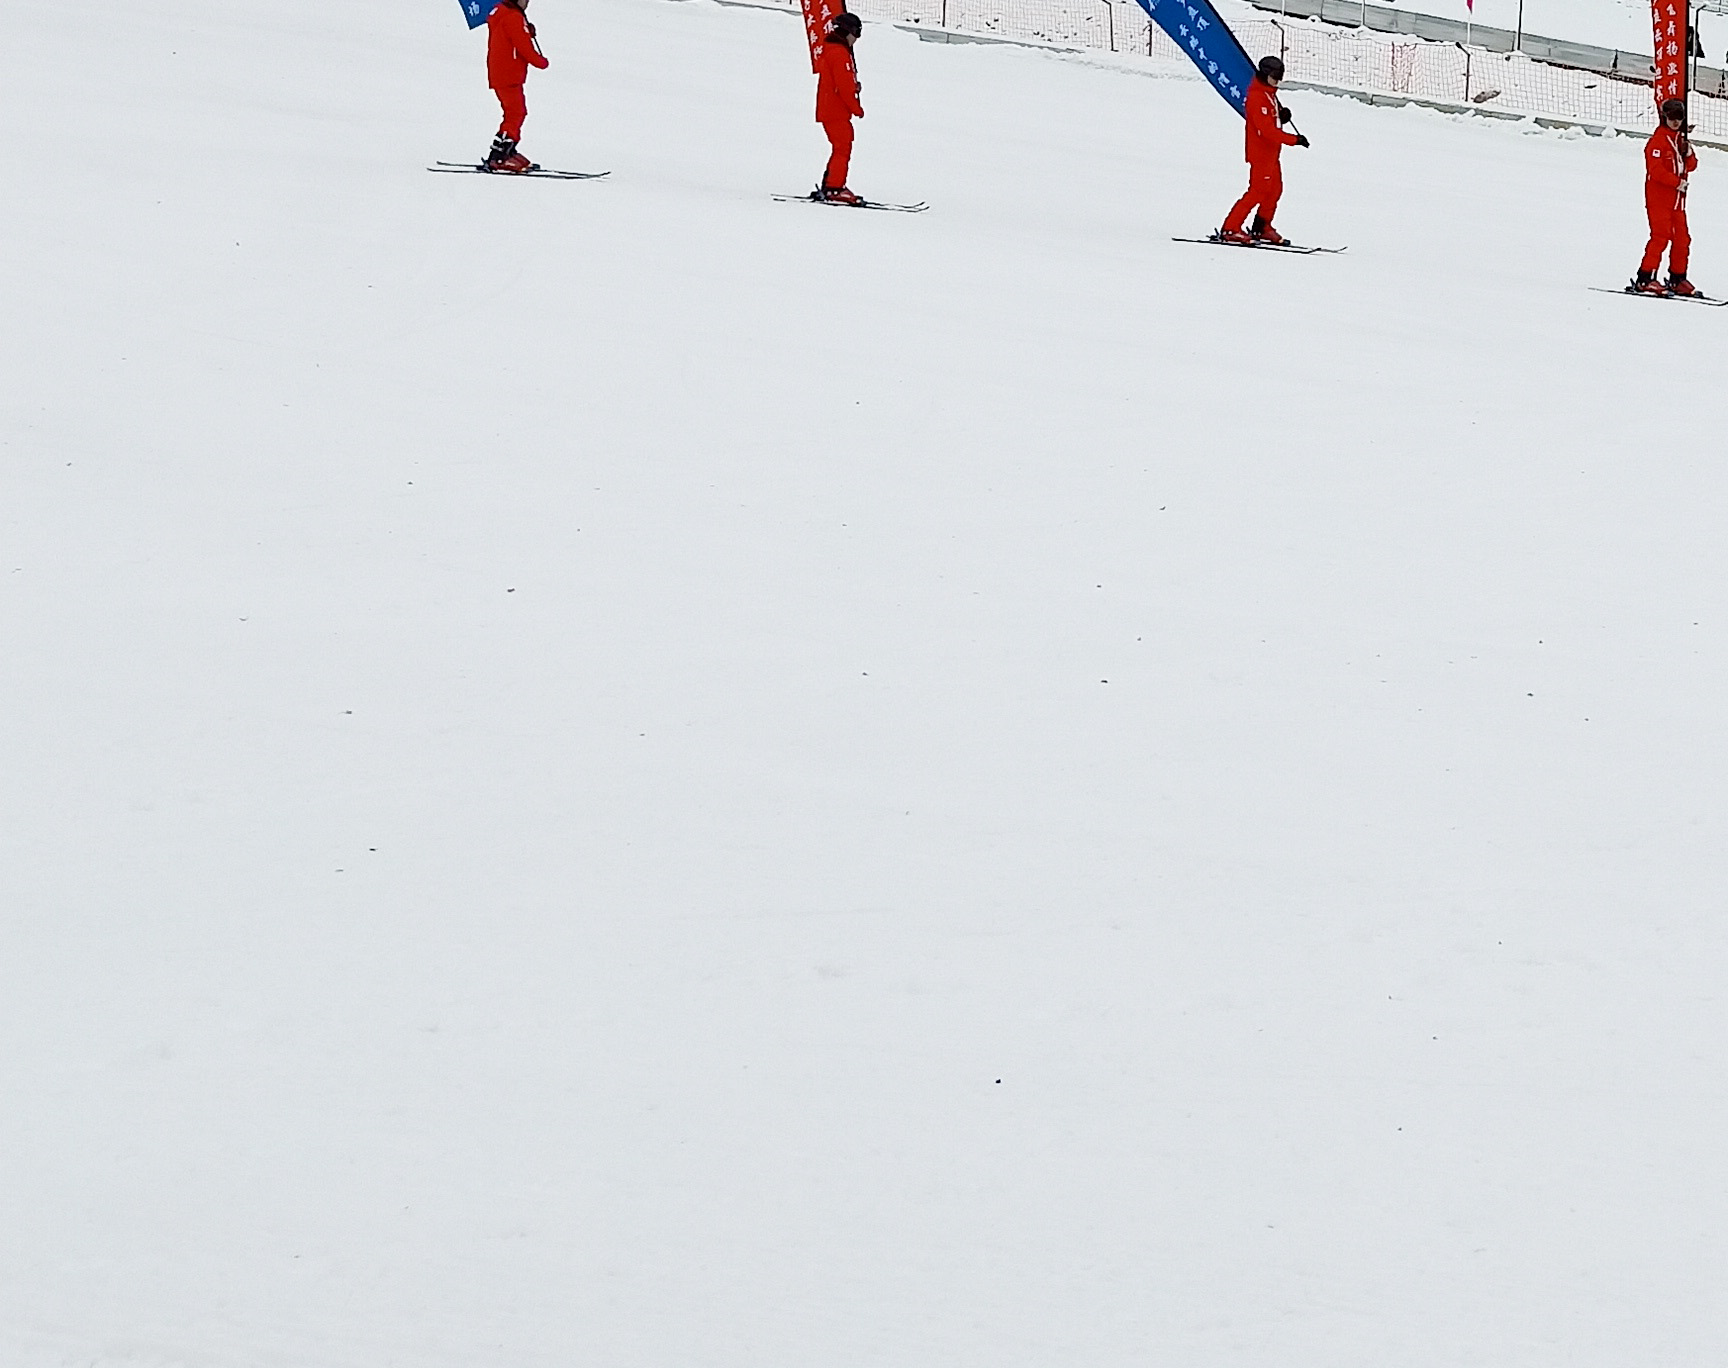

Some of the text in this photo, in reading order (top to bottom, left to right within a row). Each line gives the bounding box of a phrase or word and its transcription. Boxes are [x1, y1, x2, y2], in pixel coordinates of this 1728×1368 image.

[1179, 23, 1247, 107] 云端中的滑雪
